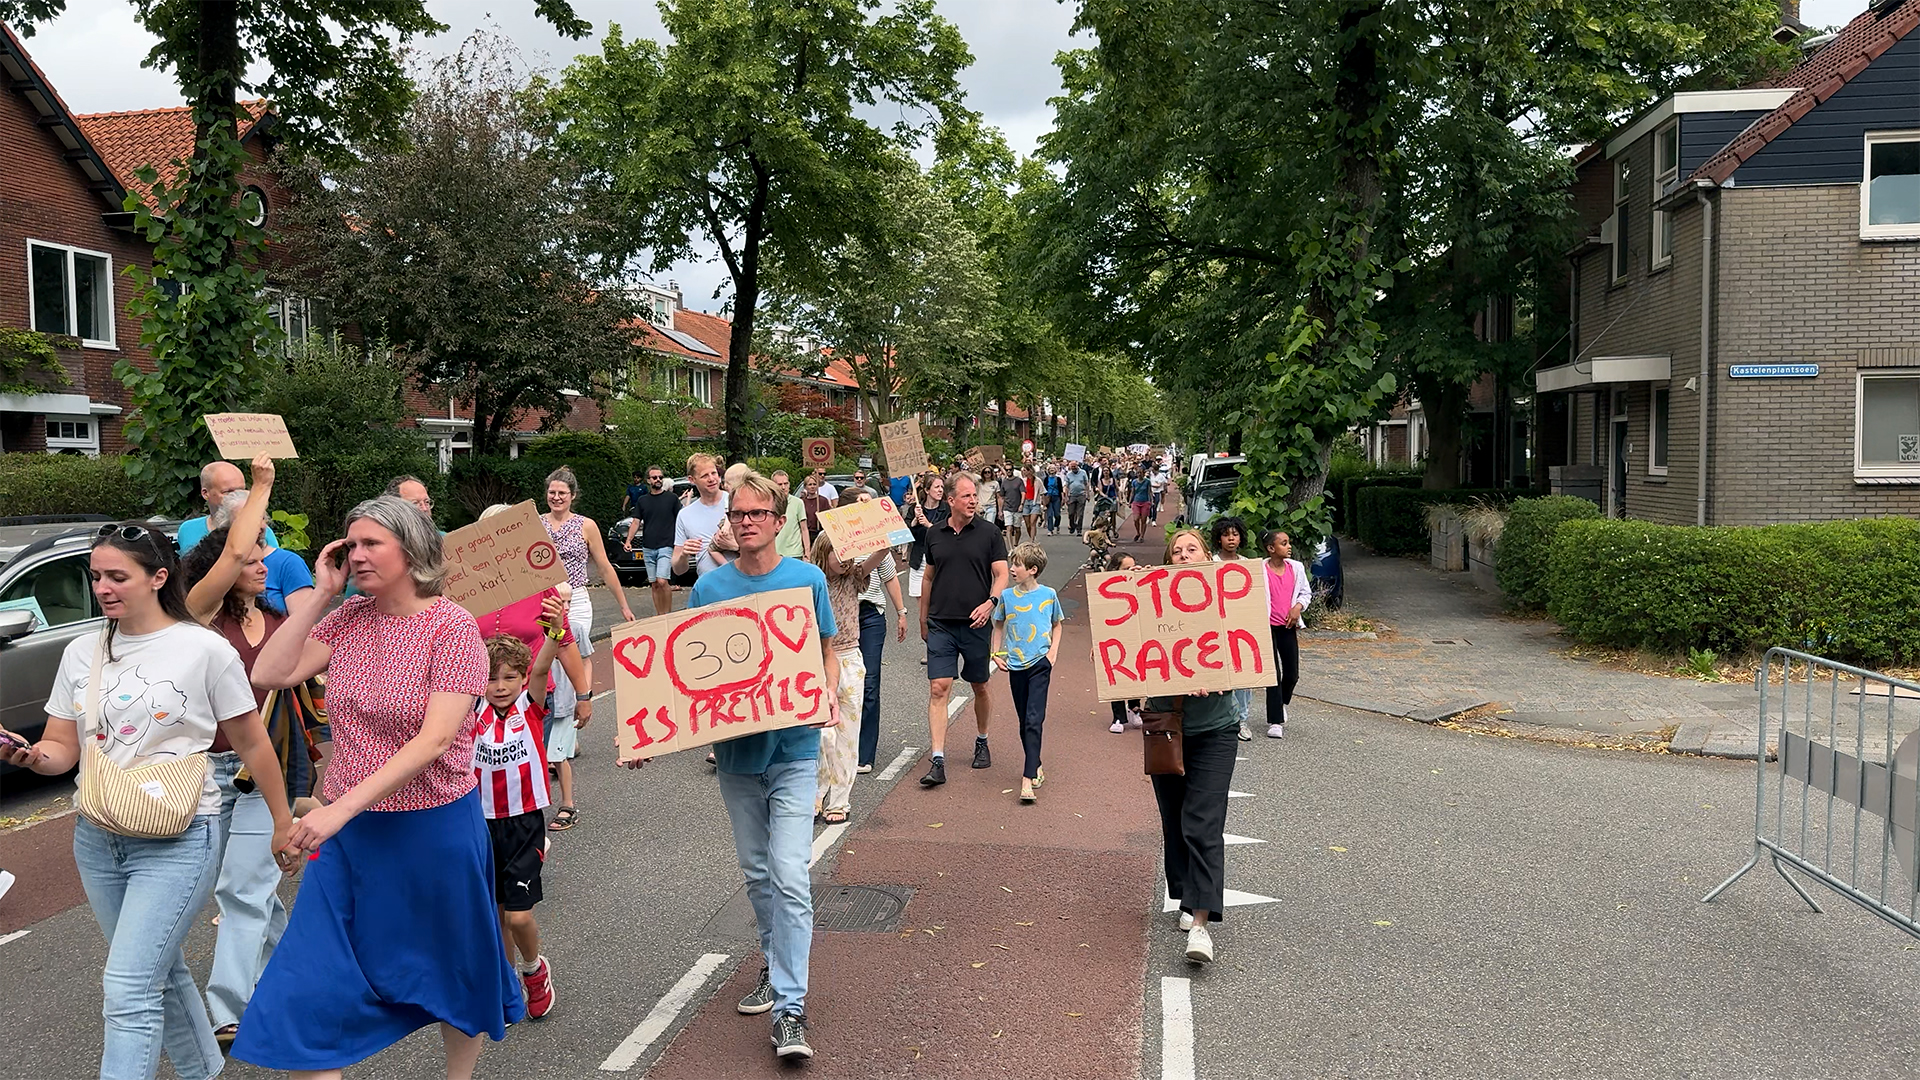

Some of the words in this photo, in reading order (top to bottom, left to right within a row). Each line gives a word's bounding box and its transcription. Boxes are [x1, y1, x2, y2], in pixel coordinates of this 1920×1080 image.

[1733, 366, 1815, 374] Kastelenplantsoen
[883, 422, 909, 438] DOE
[813, 446, 826, 456] 30
[455, 545, 464, 563] je
[467, 534, 495, 553] graag
[472, 561, 490, 571] een
[494, 545, 522, 565] potje
[532, 548, 551, 563] 30
[1098, 563, 1252, 626] STOP
[1157, 620, 1184, 633] met
[686, 632, 751, 680] 30
[626, 706, 678, 750] IS
[688, 671, 823, 735] PRETTIG
